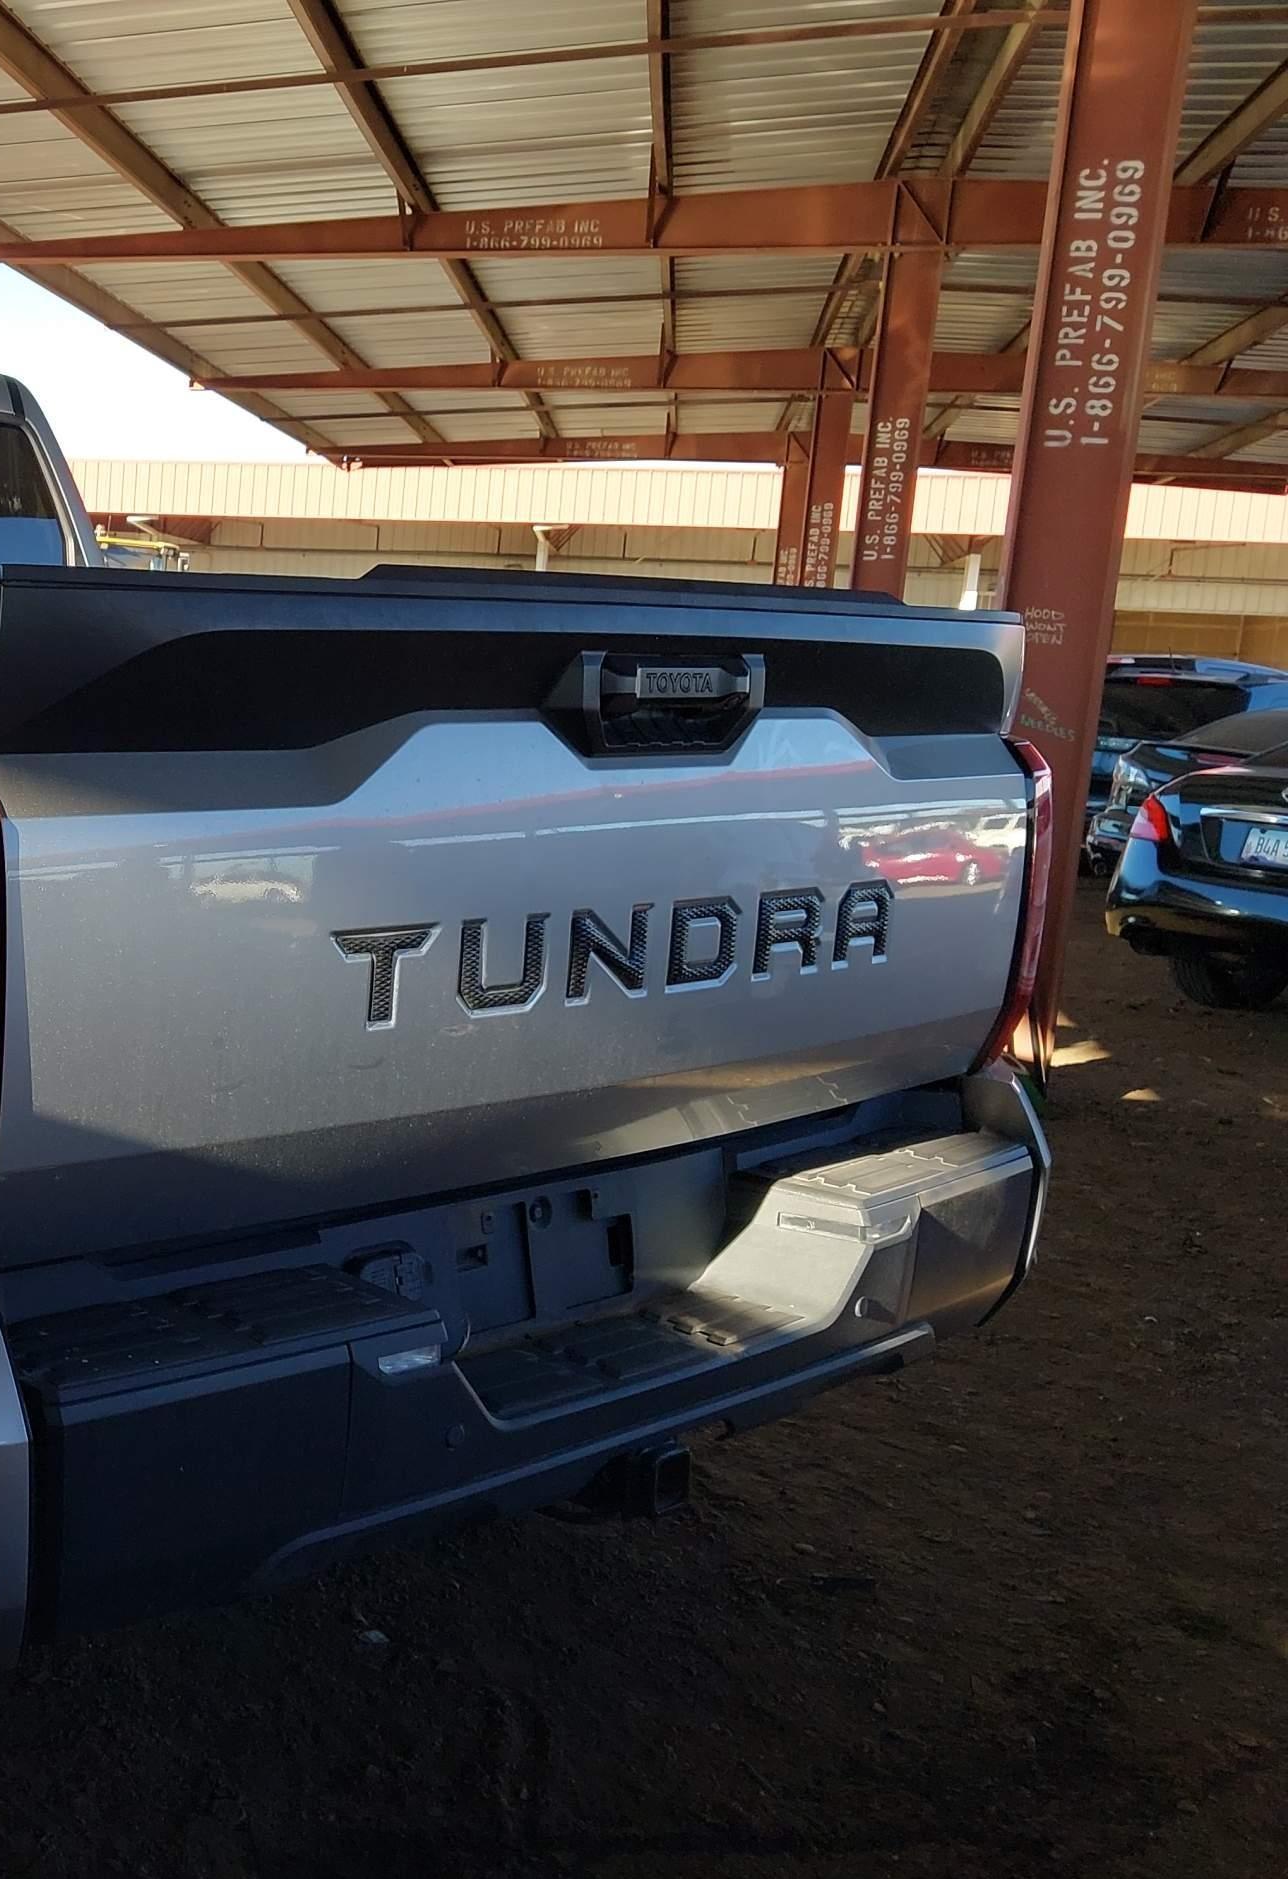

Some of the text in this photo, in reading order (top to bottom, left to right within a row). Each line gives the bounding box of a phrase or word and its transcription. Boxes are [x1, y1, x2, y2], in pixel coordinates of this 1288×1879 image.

[465, 220, 495, 235] U.S.
[1043, 158, 1109, 448] U.S. PREFAB INC.
[1080, 159, 1145, 446] 1-866-799-0969
[862, 416, 894, 561] U.S. PREFAB INC.
[881, 417, 911, 560] 1-866-799-0969
[645, 672, 713, 693] TOYOTA
[329, 878, 896, 1031] TUNDRA
